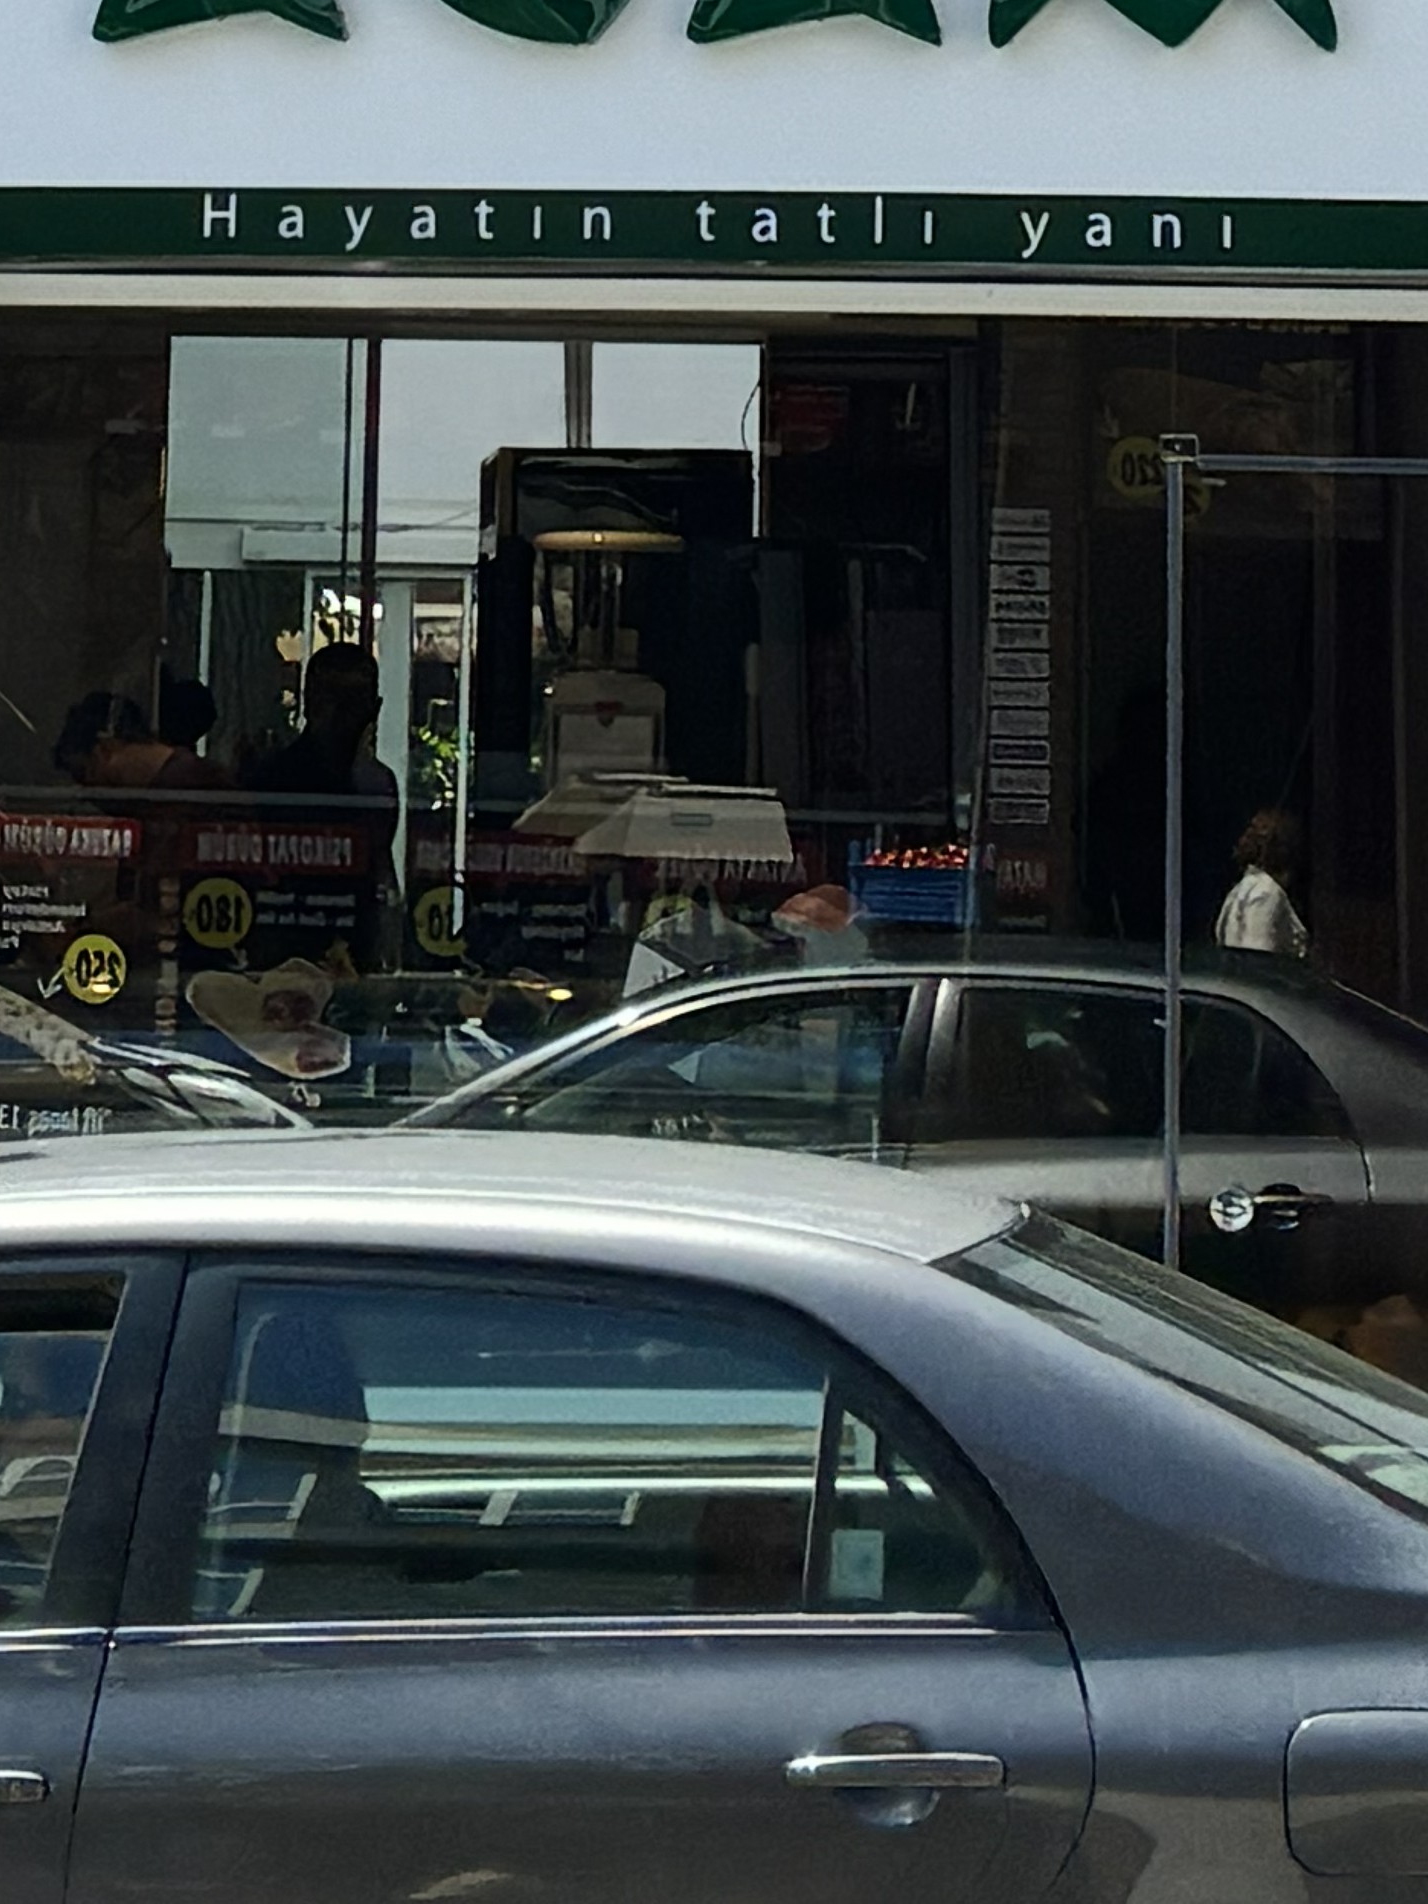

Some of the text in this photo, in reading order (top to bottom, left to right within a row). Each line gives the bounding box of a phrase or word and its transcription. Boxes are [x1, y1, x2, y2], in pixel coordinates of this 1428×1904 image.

[202, 192, 1232, 259] Hayatın tatlı yanı
